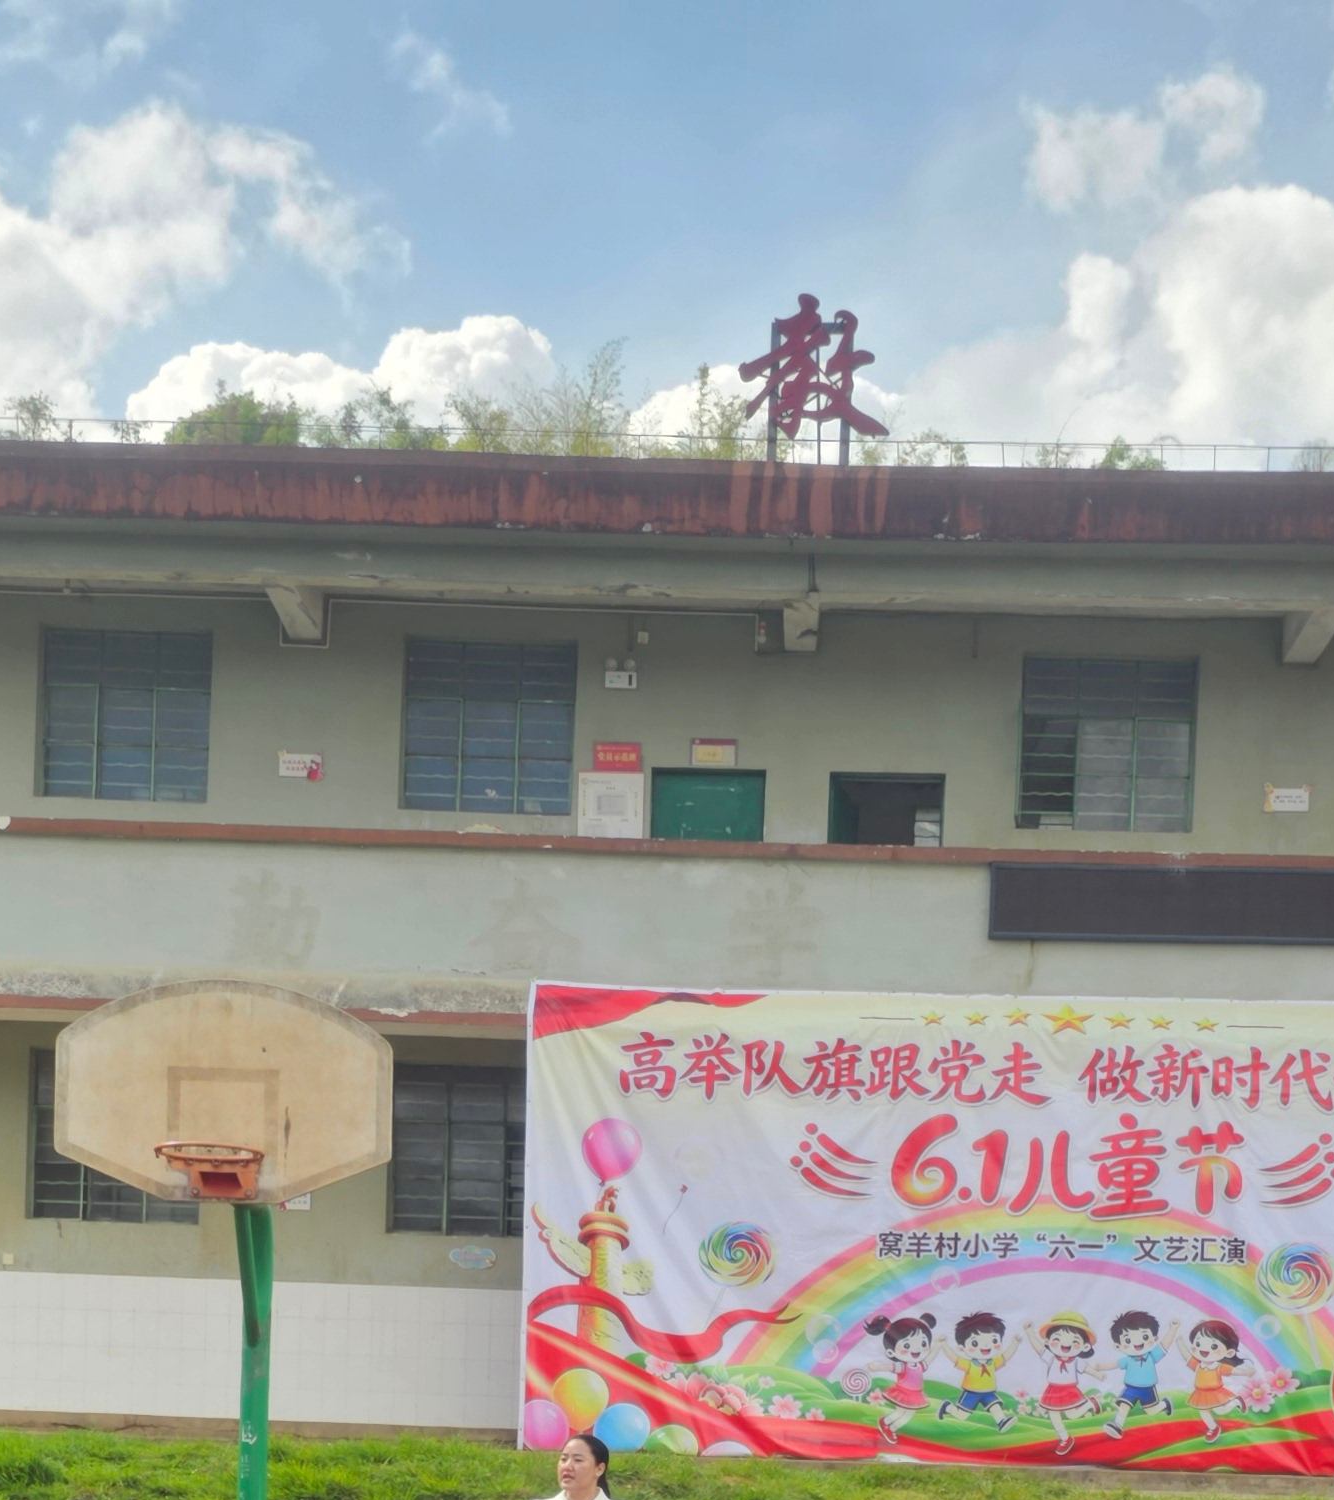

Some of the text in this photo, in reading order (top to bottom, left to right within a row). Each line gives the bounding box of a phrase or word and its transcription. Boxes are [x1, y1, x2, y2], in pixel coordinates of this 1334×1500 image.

[619, 1032, 1050, 1107] 高举队旗跟党走
[891, 1113, 1245, 1217] 6.1儿童节
